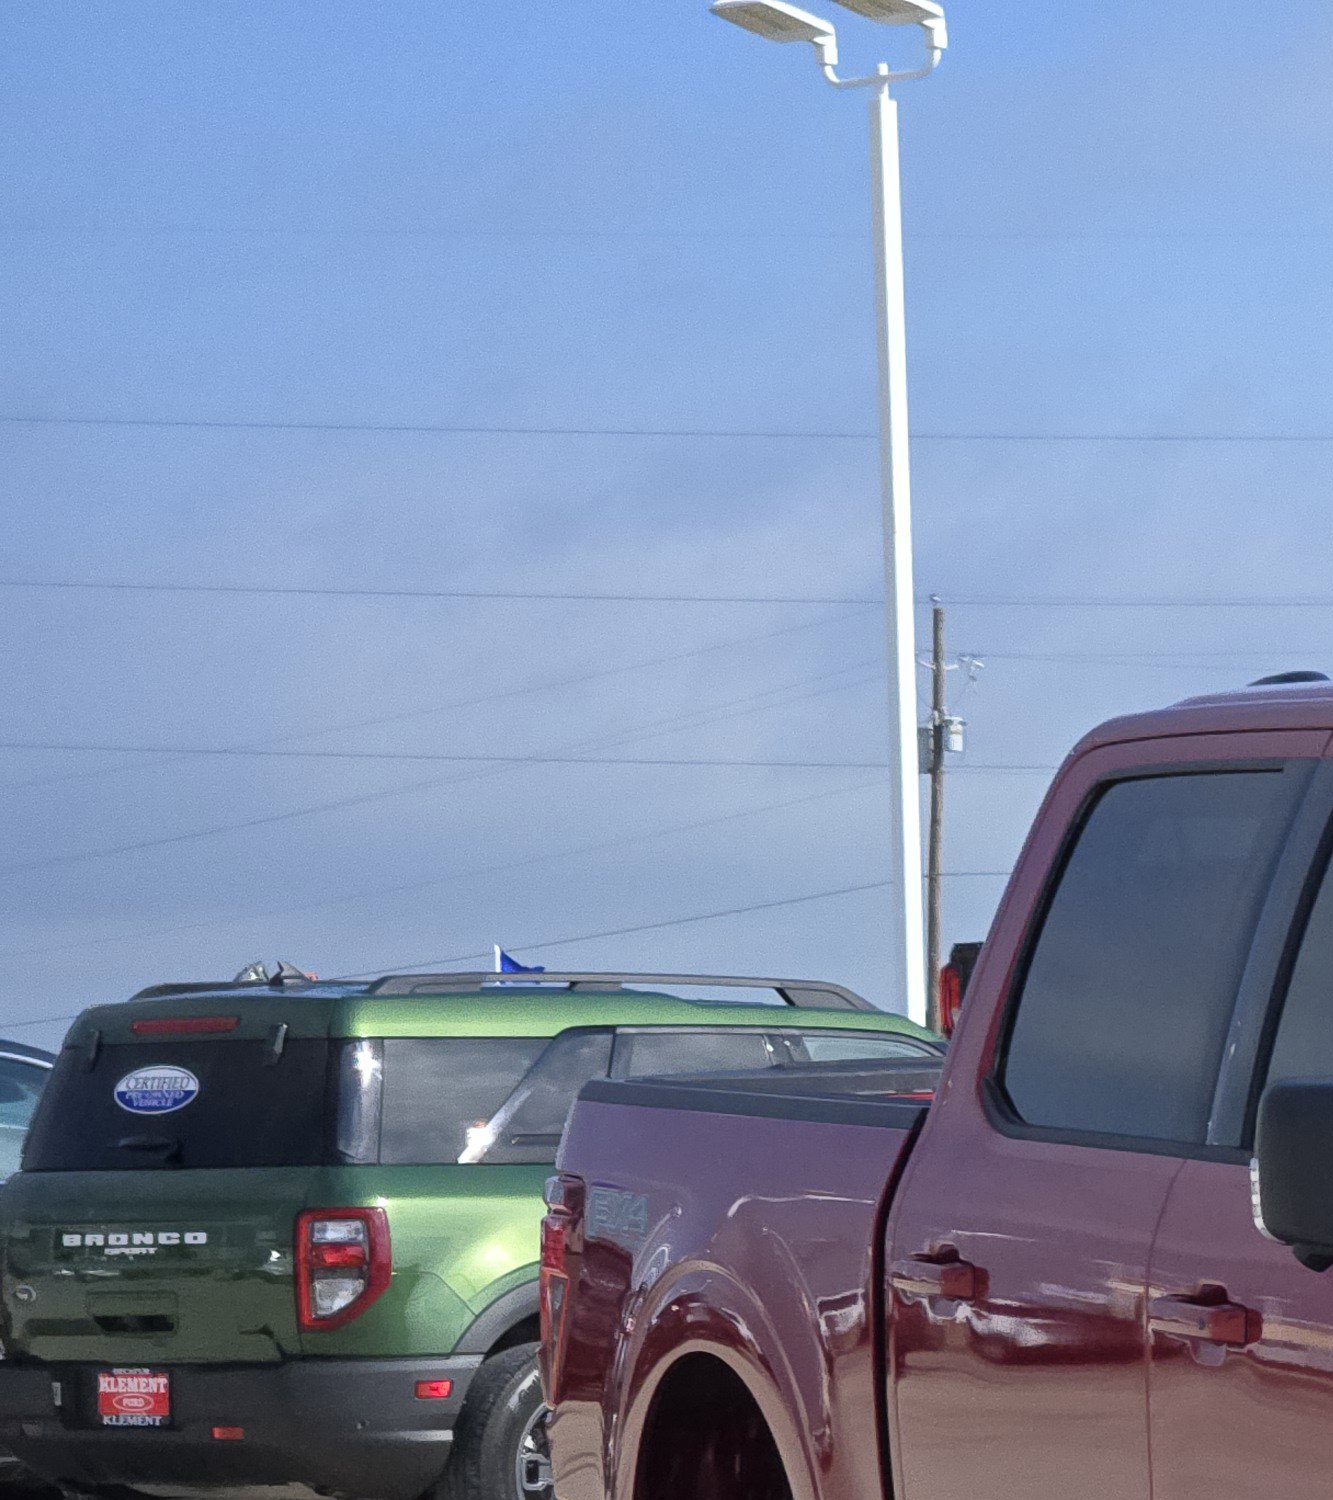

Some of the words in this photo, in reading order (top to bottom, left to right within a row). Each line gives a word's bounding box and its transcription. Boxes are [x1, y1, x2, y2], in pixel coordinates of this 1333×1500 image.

[62, 1231, 208, 1247] BRONCO
[99, 1376, 168, 1393] KLEMENT
[103, 1415, 162, 1426] KLEMENT
